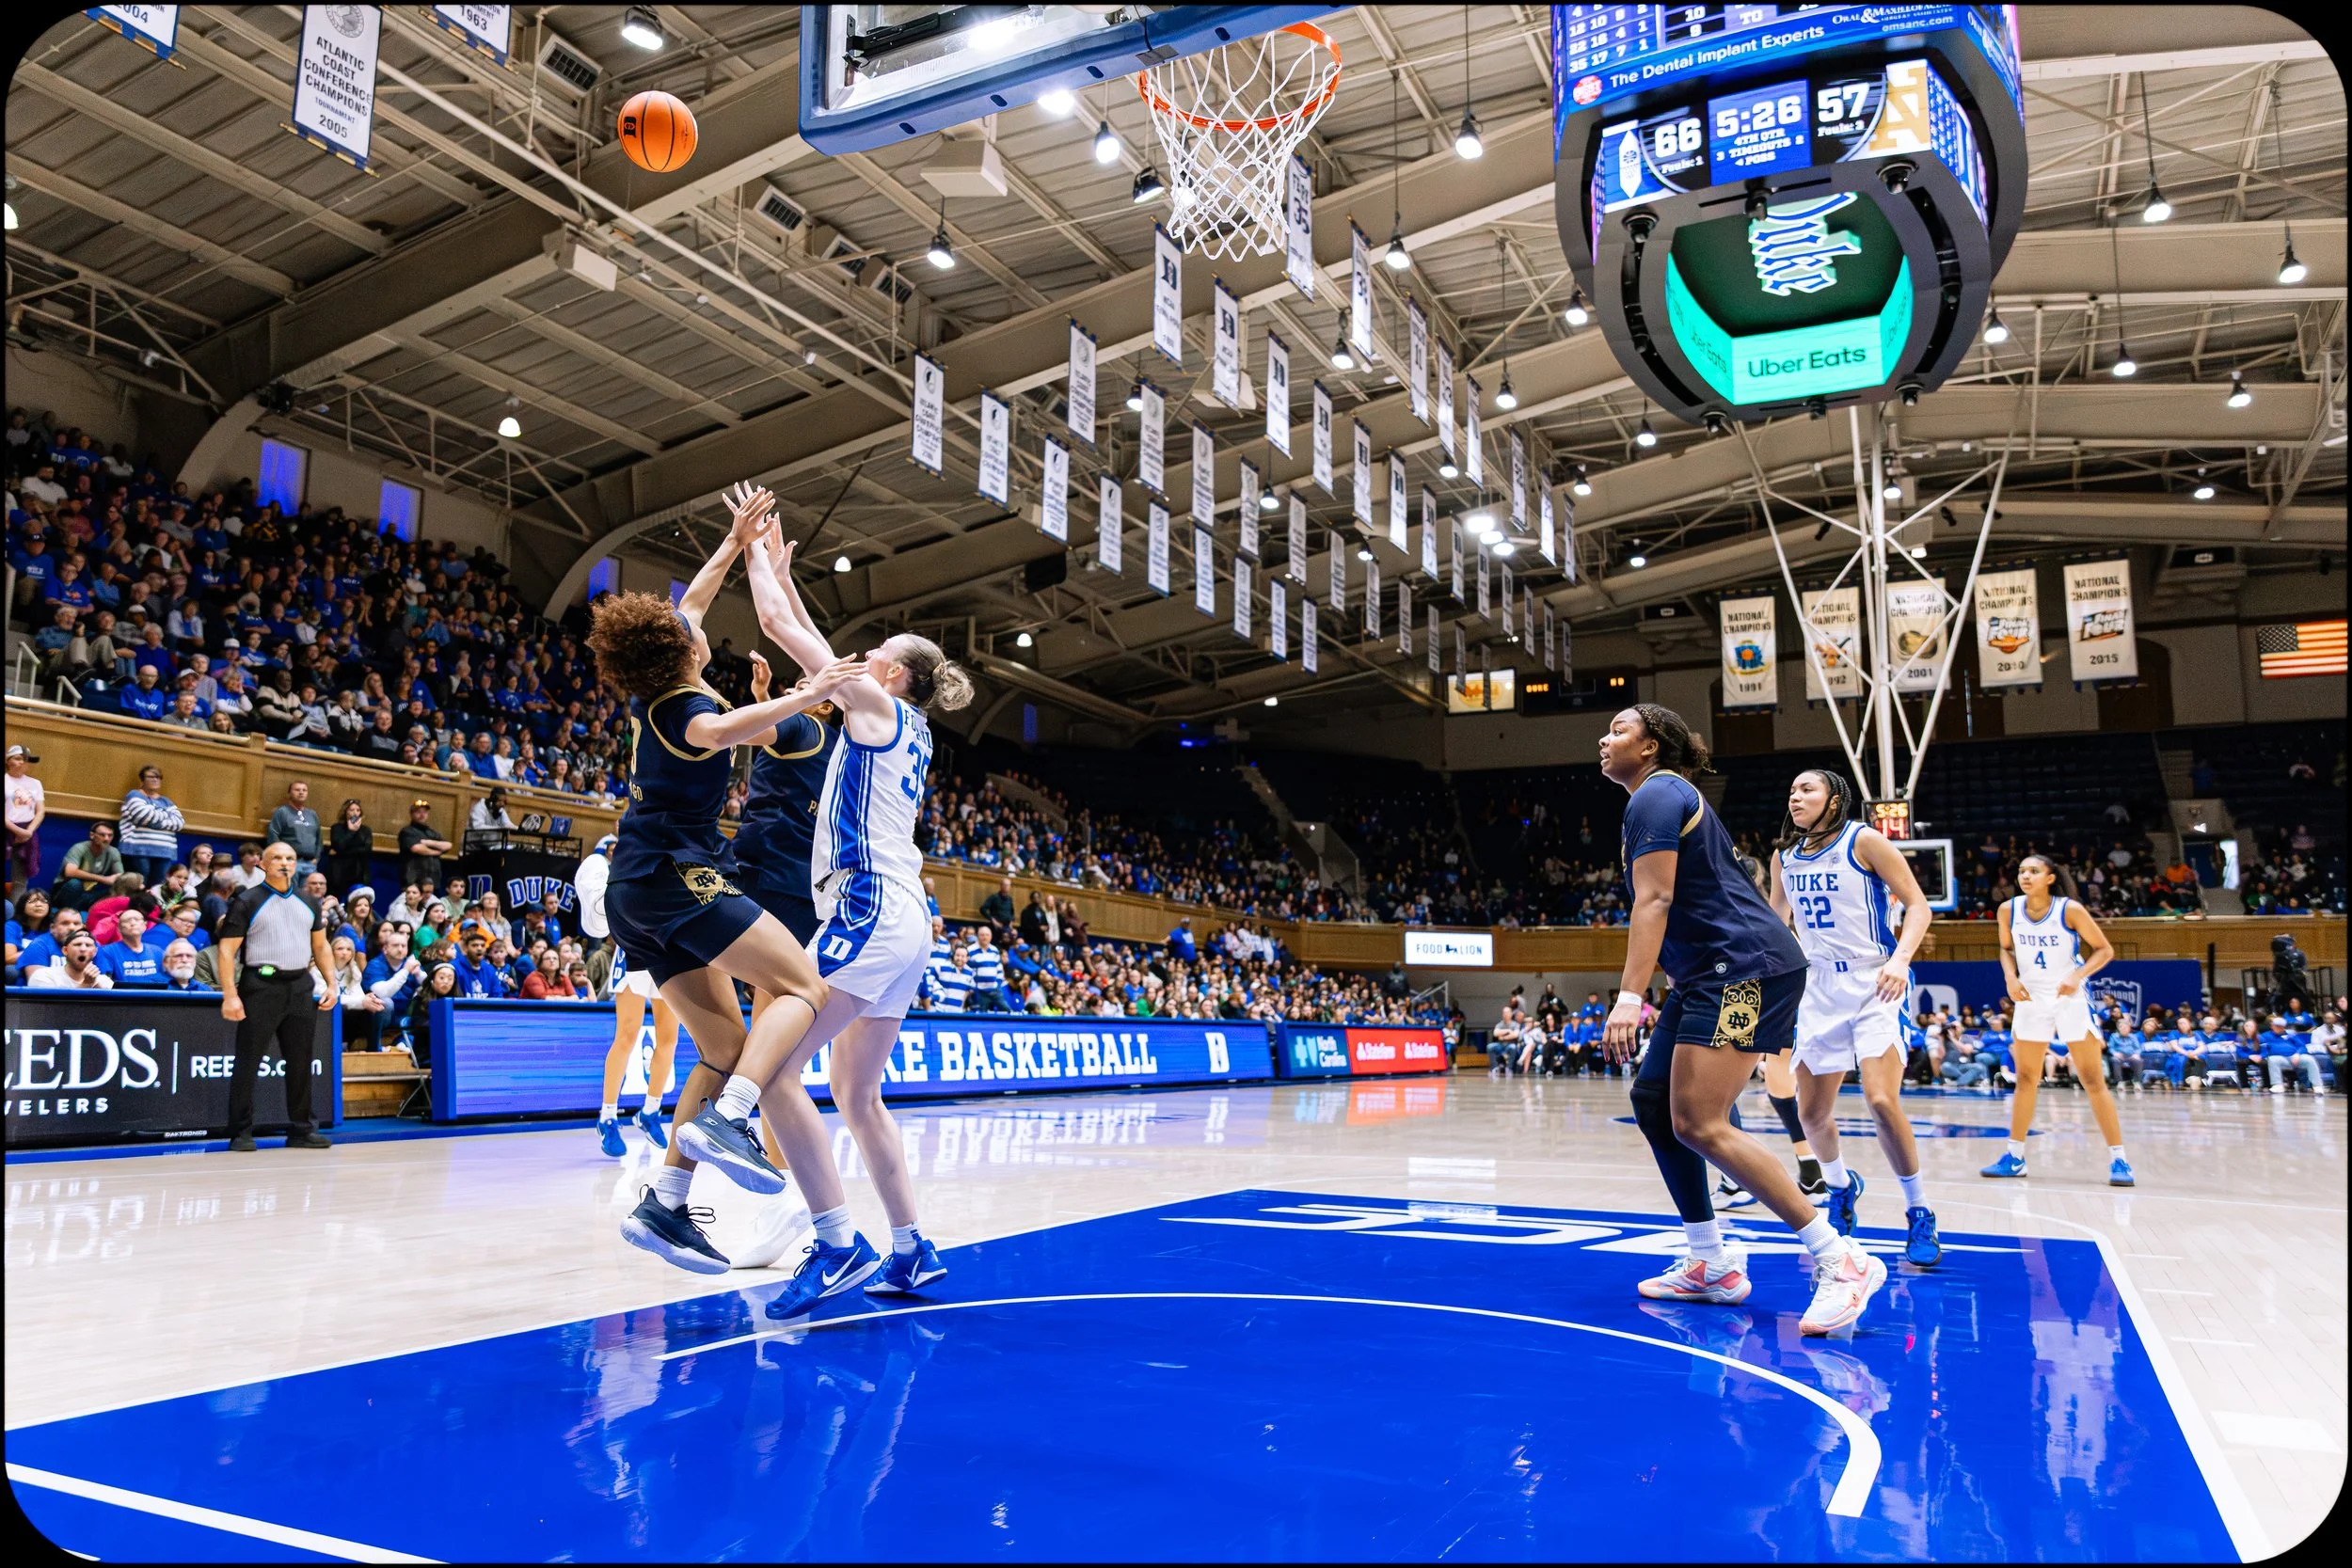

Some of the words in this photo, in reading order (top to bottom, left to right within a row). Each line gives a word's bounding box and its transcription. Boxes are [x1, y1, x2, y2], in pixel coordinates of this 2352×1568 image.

[460, 6, 487, 31] 1963
[1590, 15, 1607, 30] 10
[1685, 6, 1706, 23] 10
[1615, 26, 1626, 39] 4
[1638, 20, 1648, 33] 1
[1882, 16, 1954, 32] omsanc.com
[316, 36, 364, 71] ATLANTIC
[1569, 57, 1588, 73] 35
[1591, 50, 1608, 66] 17
[1616, 44, 1627, 57] 7
[1639, 39, 1648, 51] 1
[1610, 71, 1639, 88] The
[1643, 54, 1692, 79] Dental
[1697, 39, 1757, 64] Implant
[1761, 25, 1825, 49] Experts
[323, 54, 356, 81] COAST
[304, 58, 372, 104] CONFERENCE
[306, 74, 368, 117] CHAMPIONS
[1818, 82, 1869, 122] 57
[315, 97, 356, 124] TOURNAMENT
[1716, 95, 1802, 138] 5:26
[319, 114, 348, 138] 2005
[1818, 123, 1854, 137] Fouls:
[1655, 118, 1702, 158] 66
[1734, 133, 1759, 146] 4TH
[1760, 128, 1786, 142] QTR
[1728, 137, 1791, 158] TIMEOUTS
[1661, 158, 1694, 174] Fouls:
[1745, 150, 1776, 166] POSS
[1294, 197, 1310, 234] 35
[1748, 357, 1804, 377] Uber
[1809, 346, 1867, 369] Eats
[1982, 585, 2026, 597] NATIONAL
[2074, 576, 2120, 589] NATIONAL
[1979, 596, 2033, 610] CHAMPIONS
[2071, 588, 2127, 601] CHAMPIONS
[1727, 610, 1768, 622] NATIONAL
[1811, 602, 1851, 613] NTIONAL
[1724, 622, 1772, 634] CHAMPIONS
[1811, 612, 1855, 626] HAMPIONS
[2090, 654, 2119, 665] 2015
[1828, 674, 1846, 686] 992
[1907, 668, 1932, 678] 2001
[1789, 874, 1838, 892] DUKE
[507, 876, 577, 912] DUKE
[1799, 896, 1835, 929] 22
[822, 934, 853, 960] D
[1416, 943, 1442, 954] FOOD
[1460, 944, 1482, 955] LION
[2019, 934, 2059, 947] DUKE
[2034, 951, 2047, 969] 4
[937, 1031, 1157, 1082] BASKETBALL
[1319, 1051, 1347, 1068] Carolina
[191, 1055, 322, 1079] REES.cm
